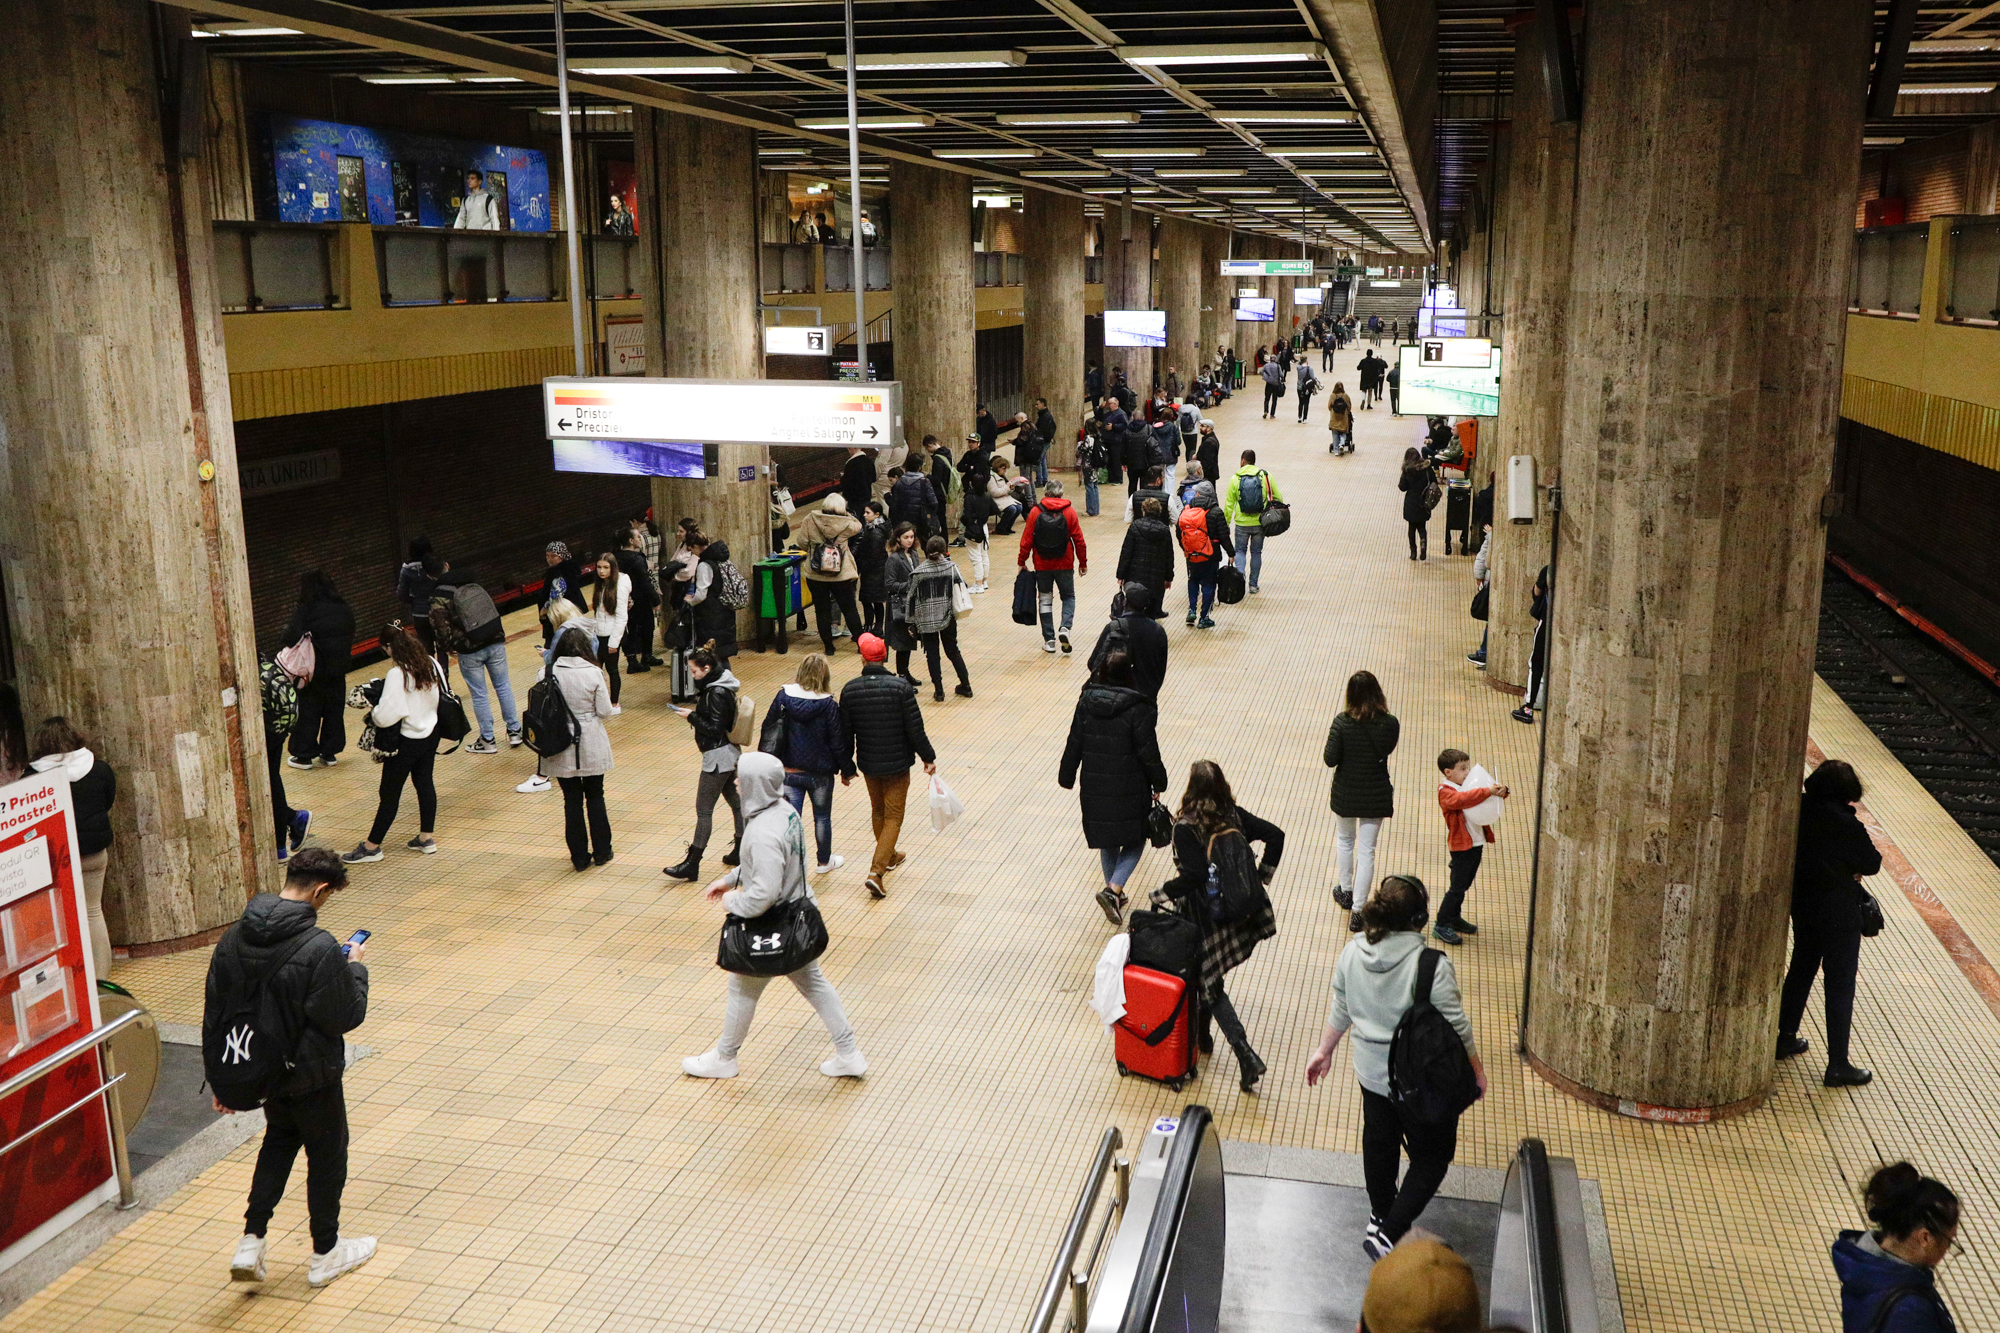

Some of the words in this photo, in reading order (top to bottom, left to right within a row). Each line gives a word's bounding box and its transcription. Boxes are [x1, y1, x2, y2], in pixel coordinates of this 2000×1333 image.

[811, 338, 819, 349] 2
[1430, 349, 1436, 360] 1
[576, 407, 612, 419] Dristor
[791, 412, 856, 425] Pantelimon
[577, 421, 623, 433] Preciziei
[771, 426, 810, 439] Anghel
[814, 426, 855, 441] Saligny
[239, 467, 267, 489] ATA
[9, 786, 54, 810] Prinde
[0, 799, 57, 831] noastre!
[0, 853, 22, 870] odul
[24, 846, 40, 860] QR
[1, 868, 24, 883] vista
[221, 1023, 255, 1065] NY
